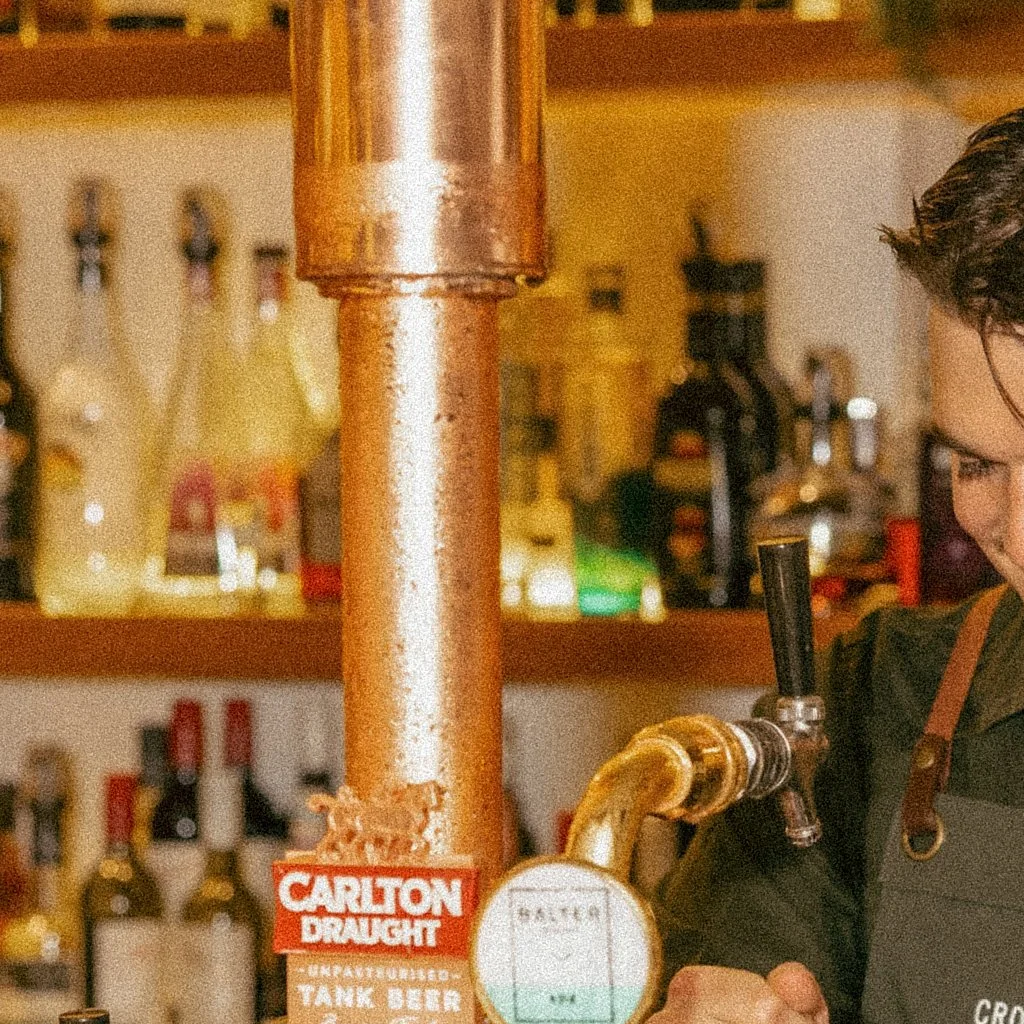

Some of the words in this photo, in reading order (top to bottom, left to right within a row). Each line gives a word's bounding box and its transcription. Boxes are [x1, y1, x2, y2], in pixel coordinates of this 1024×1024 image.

[278, 871, 463, 917] CARLTON
[300, 916, 442, 947] DRAUGHT
[297, 984, 376, 1009] TANK
[387, 986, 462, 1012] BEER
